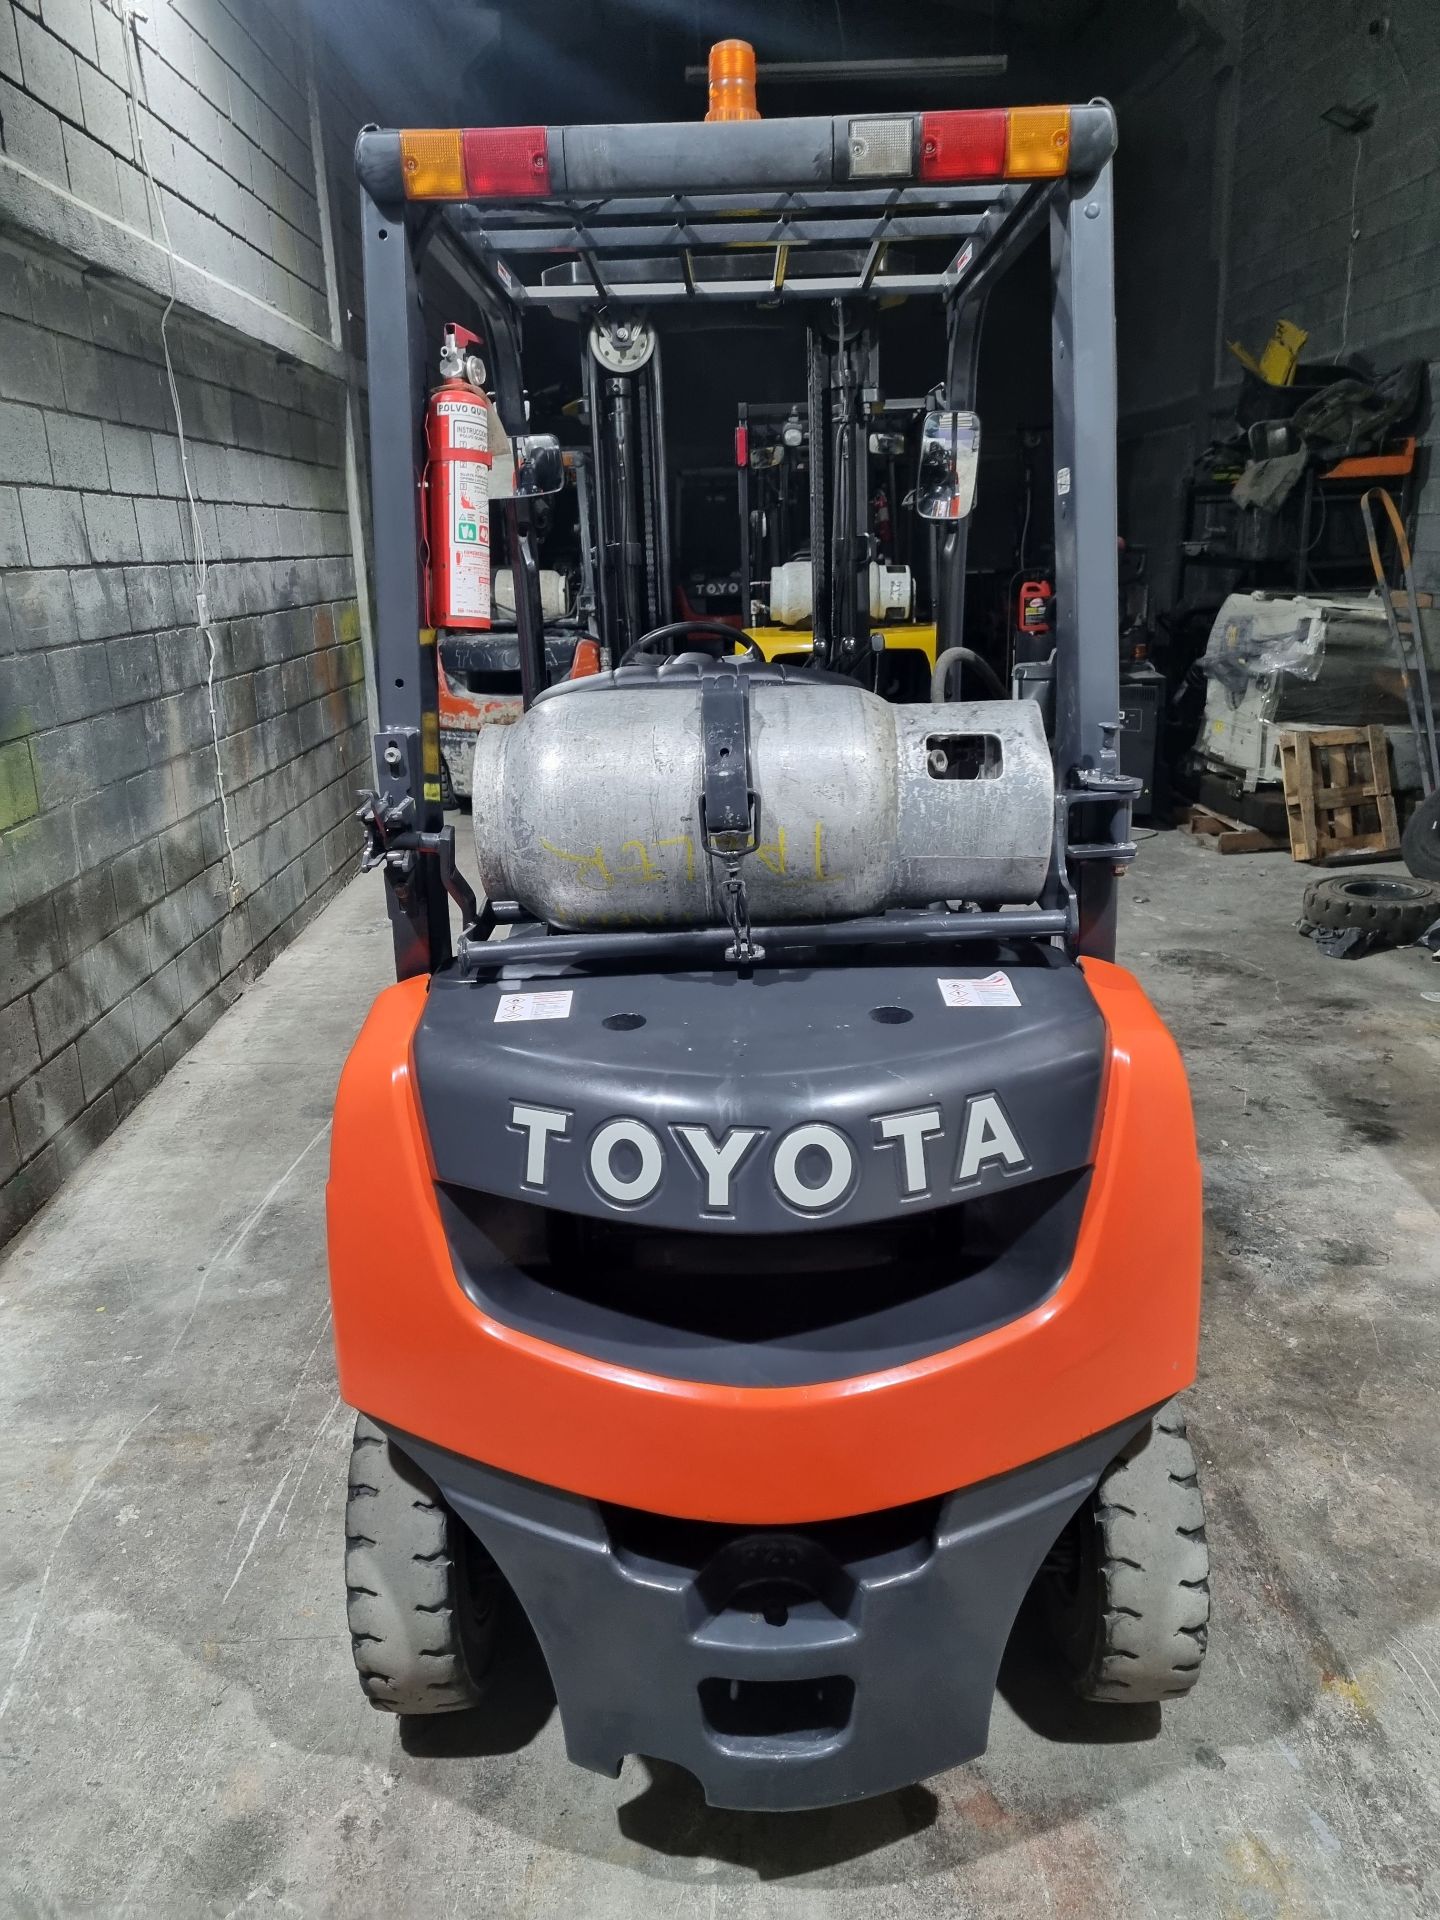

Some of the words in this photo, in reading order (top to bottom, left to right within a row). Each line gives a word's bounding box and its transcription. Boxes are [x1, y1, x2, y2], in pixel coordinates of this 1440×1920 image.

[438, 404, 468, 413] POLVO
[695, 582, 739, 595] TOYO
[538, 821, 845, 892] TALER
[511, 1096, 1027, 1210] TOYOTA
